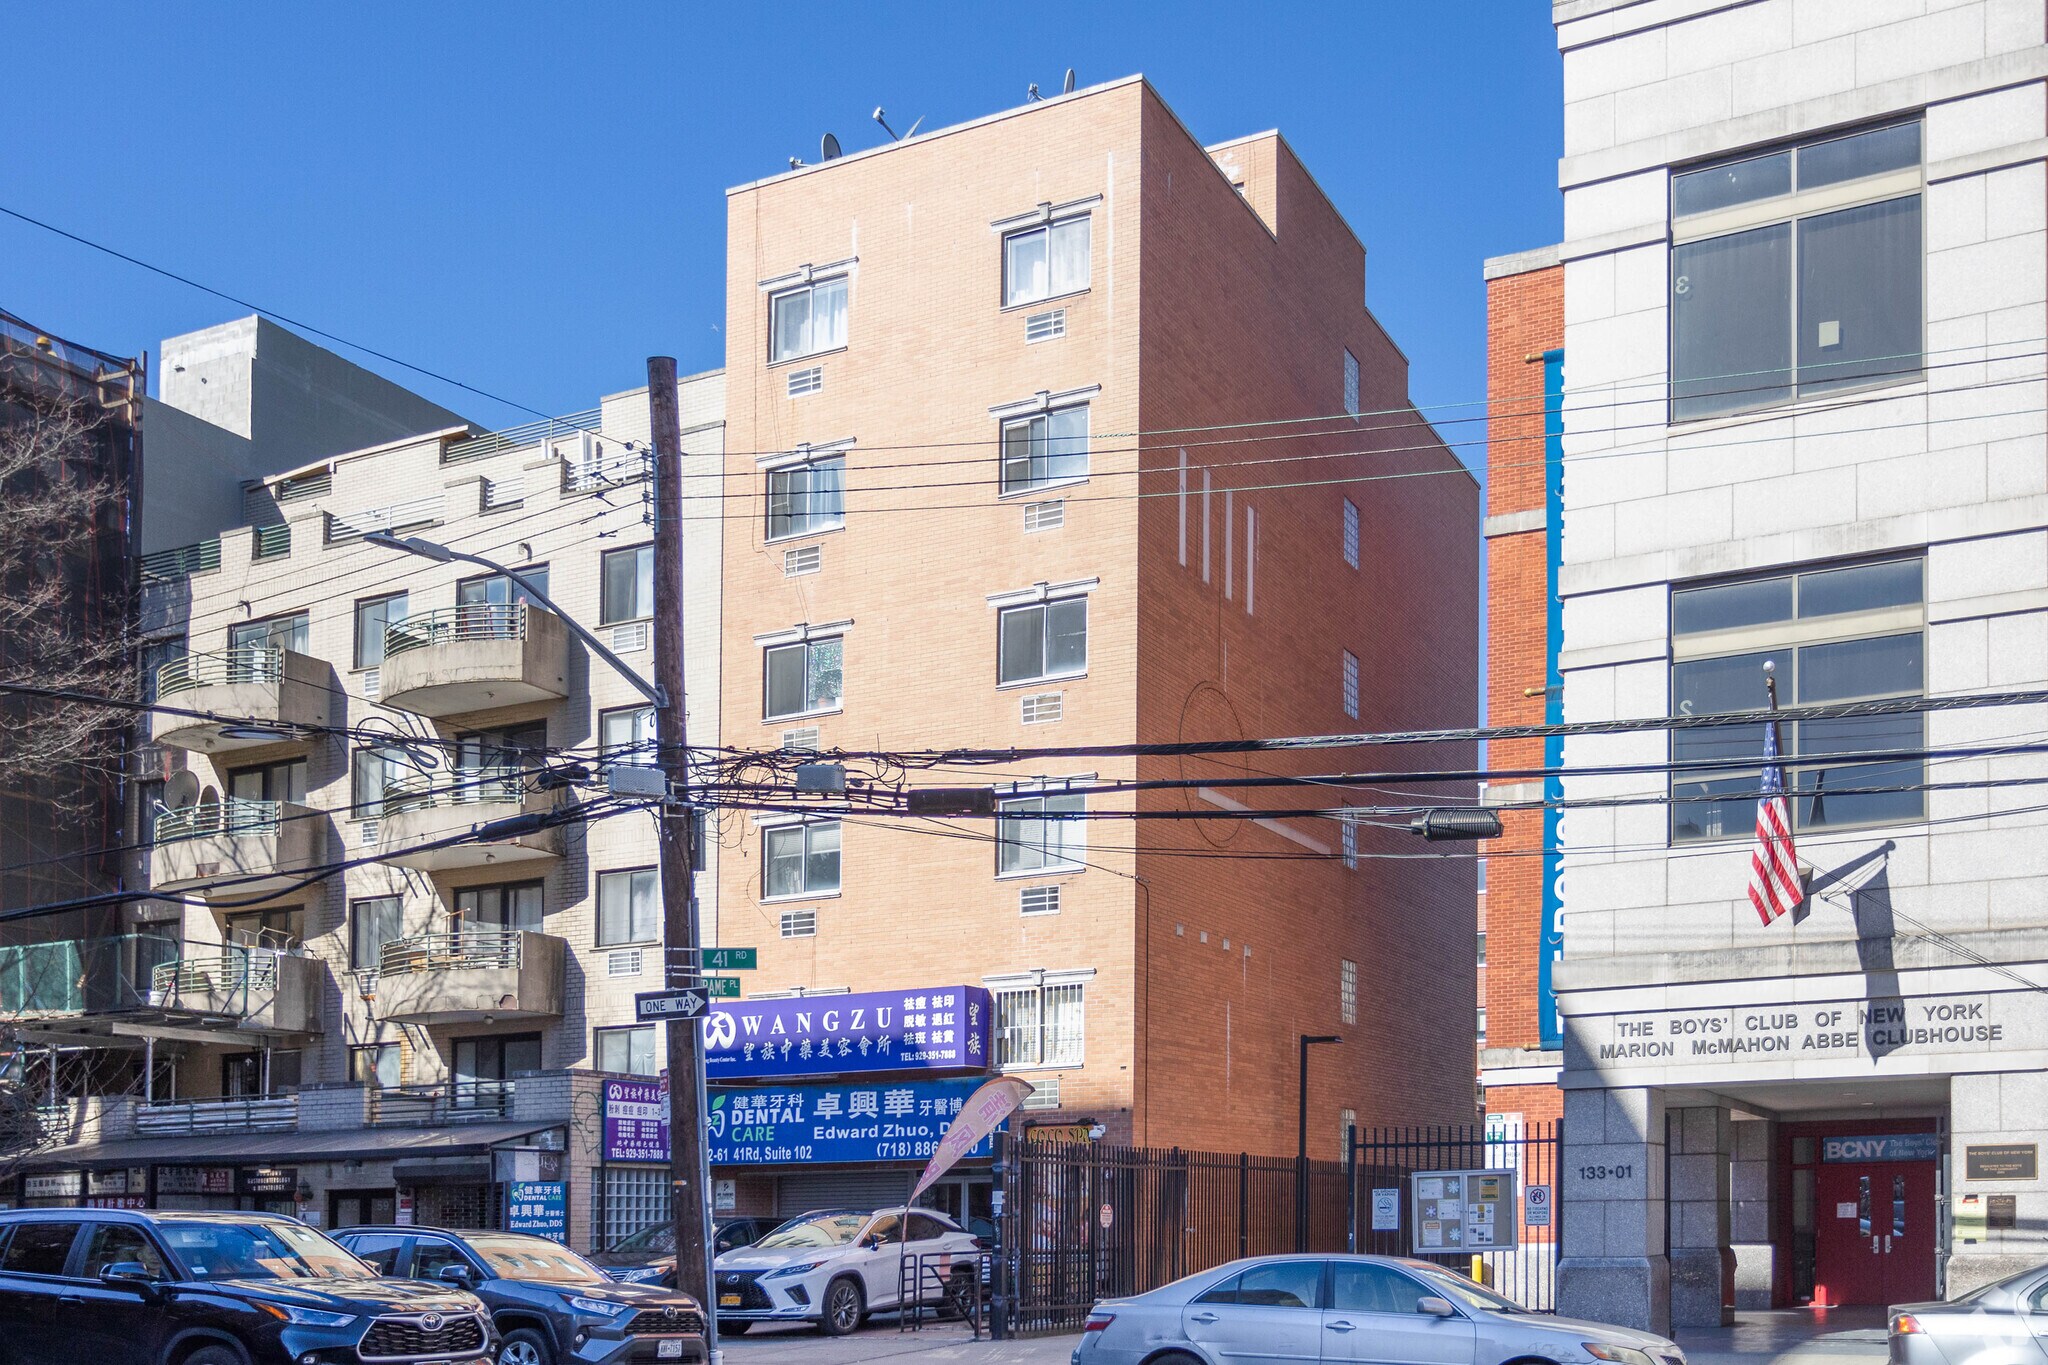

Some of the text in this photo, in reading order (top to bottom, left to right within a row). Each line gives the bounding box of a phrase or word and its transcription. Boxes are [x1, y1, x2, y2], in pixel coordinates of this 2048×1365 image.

[712, 951, 747, 967] 41 RD
[729, 980, 738, 988] PL
[645, 997, 697, 1012] ONE WAY
[741, 1007, 892, 1036] WANGZU
[1617, 1021, 1654, 1037] THE
[1744, 1013, 1799, 1031] CLUB
[1814, 1011, 1842, 1027] OF
[1859, 1007, 1906, 1025] NEW
[1922, 1003, 1983, 1021] YORK
[1600, 1024, 2003, 1059] MARION McMAHON ABBE CLUBHOUSE
[901, 1052, 914, 1061] TEL:
[813, 1089, 915, 1120] 卓興華
[731, 1107, 805, 1125] DENTAL
[731, 1126, 775, 1142] CARE
[813, 1125, 879, 1140] Edward
[883, 1123, 934, 1138] Zhuo,
[876, 1141, 911, 1158] (718)
[1826, 1140, 1887, 1159] BCNY
[1889, 1139, 1902, 1147] The
[611, 1147, 625, 1158] TEL:
[764, 1146, 791, 1160] Suite
[794, 1145, 812, 1160] 102
[510, 1220, 532, 1228] Edward
[549, 1219, 563, 1227] DDS
